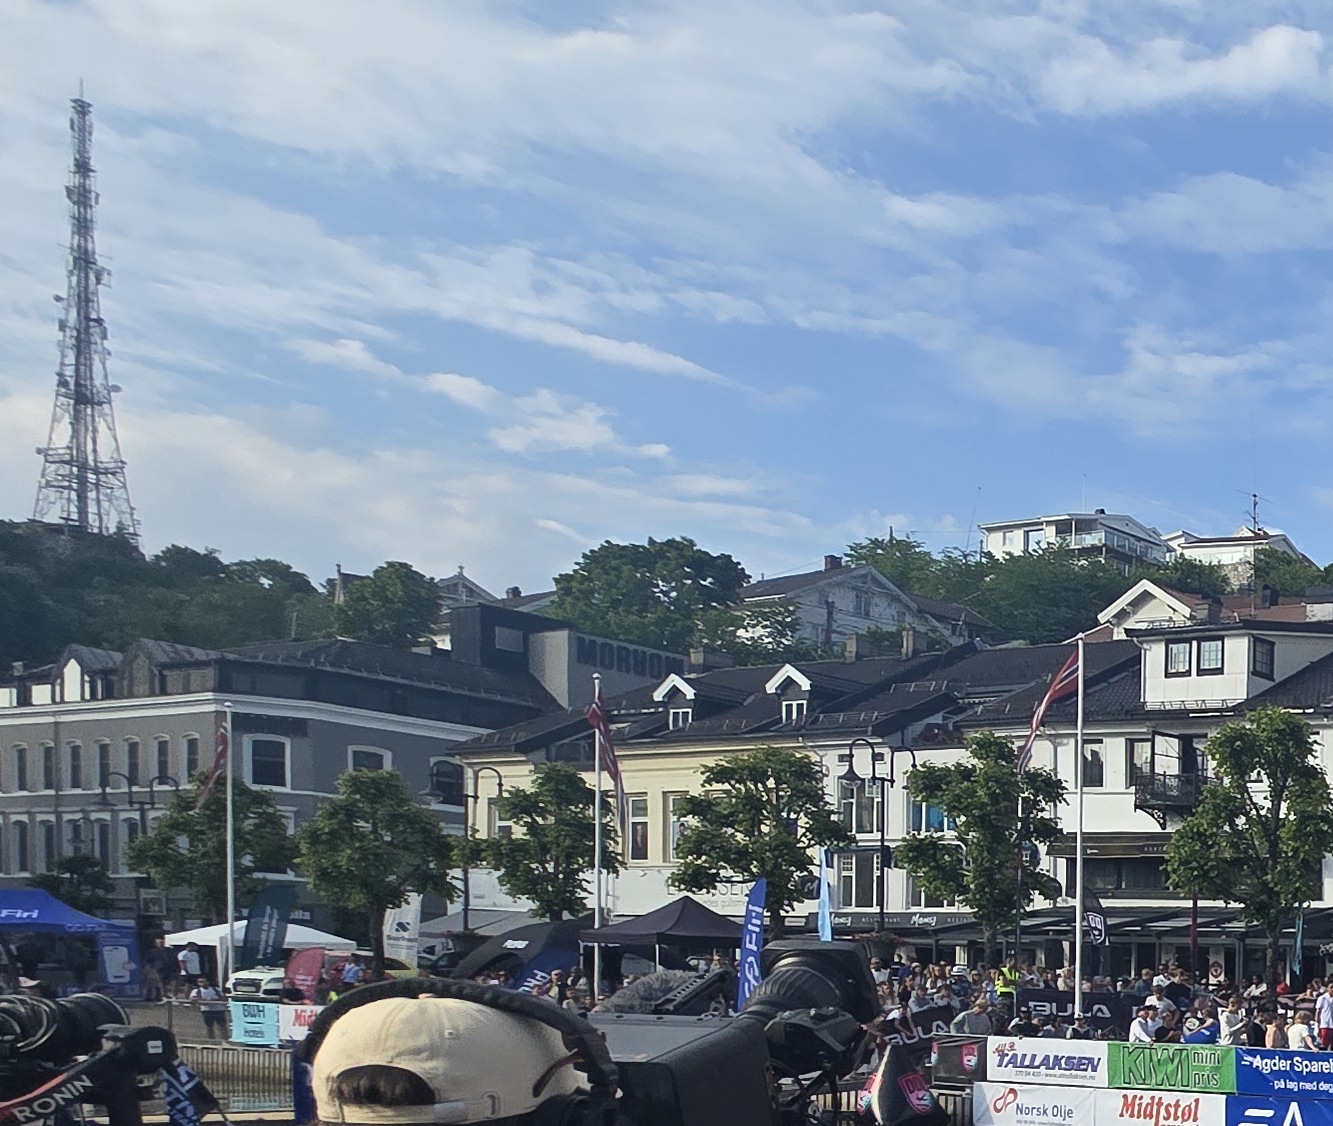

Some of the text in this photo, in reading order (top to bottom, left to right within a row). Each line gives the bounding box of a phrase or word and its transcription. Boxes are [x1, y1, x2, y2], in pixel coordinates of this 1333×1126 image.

[292, 1007, 318, 1027] Midt
[996, 1052, 1101, 1073] TALLAKSEN
[1122, 1045, 1222, 1088] KIWI mini
[1252, 1055, 1292, 1074] Agder
[1193, 1069, 1220, 1088] pris
[1274, 1079, 1285, 1090] på
[1286, 1079, 1298, 1092] lag
[1299, 1080, 1317, 1091] med
[12, 1074, 94, 1122] RONIN
[1015, 1102, 1074, 1120] Norsk Olje
